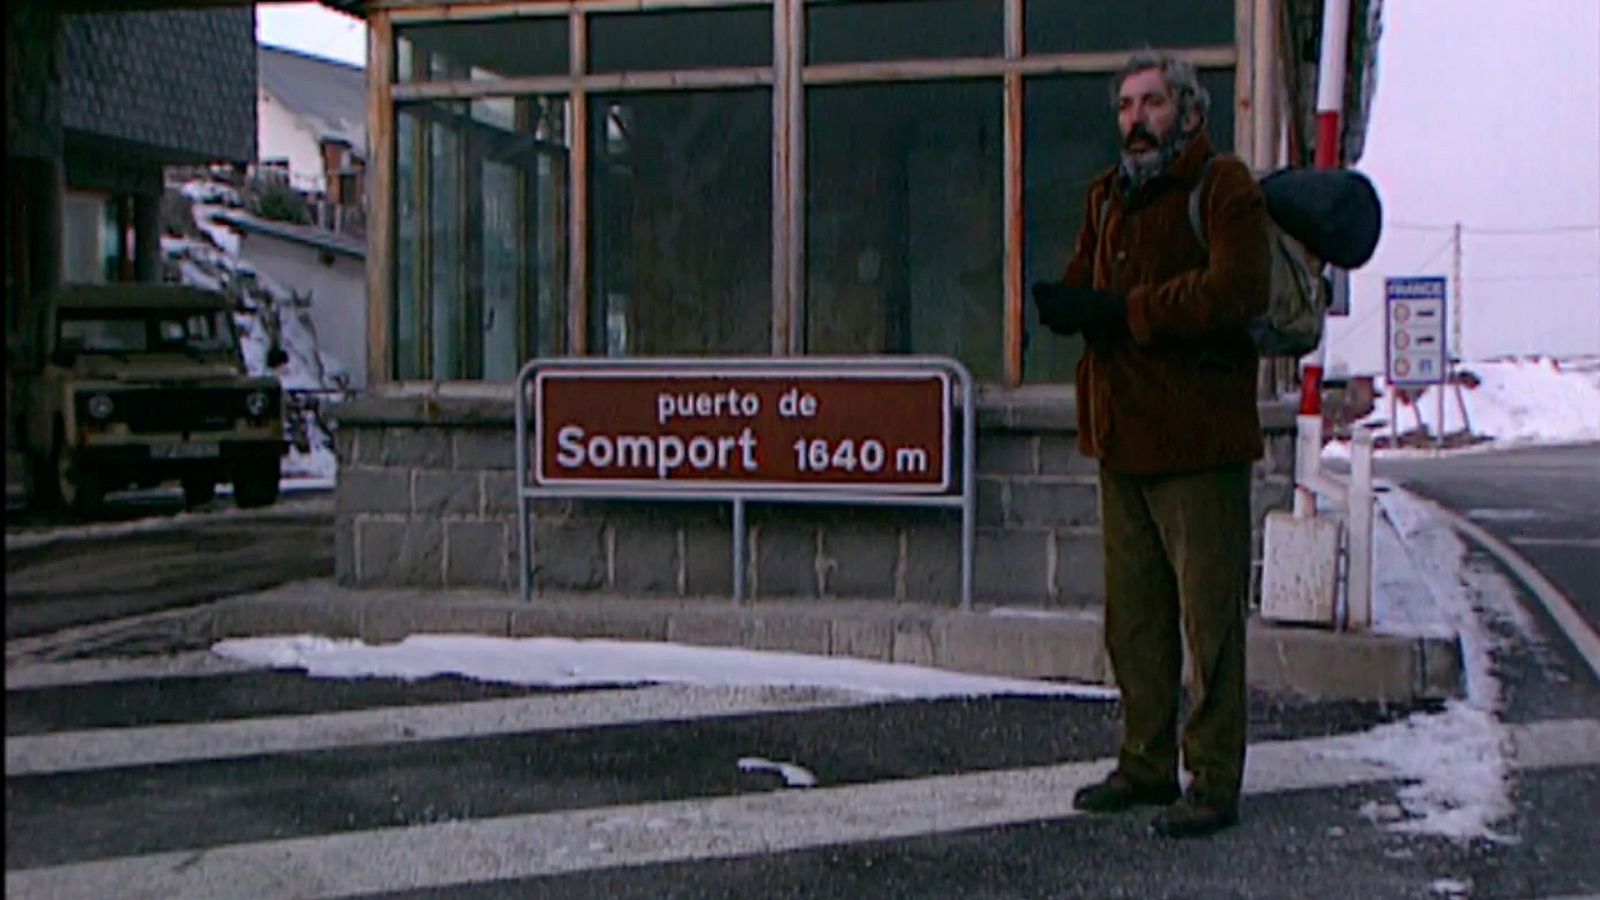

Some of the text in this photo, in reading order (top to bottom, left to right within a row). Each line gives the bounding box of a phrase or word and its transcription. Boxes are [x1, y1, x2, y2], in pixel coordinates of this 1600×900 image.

[658, 388, 818, 424] puerto de
[556, 426, 927, 479] Somport 1640 m
